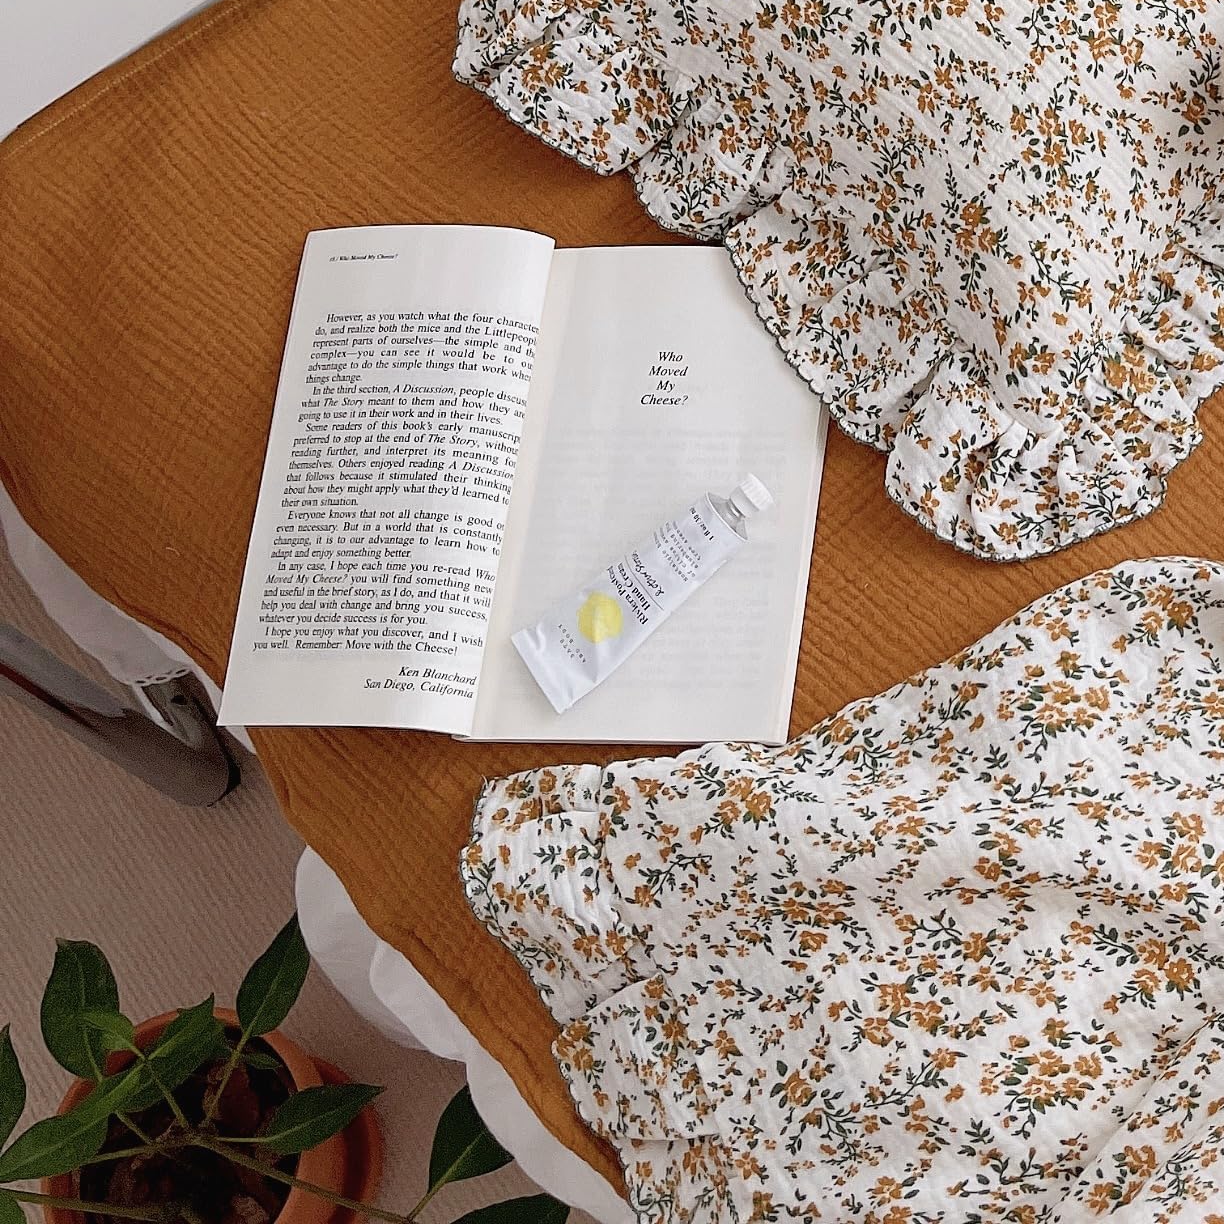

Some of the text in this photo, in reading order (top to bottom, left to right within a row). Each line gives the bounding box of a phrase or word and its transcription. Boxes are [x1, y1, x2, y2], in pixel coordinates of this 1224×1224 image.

[472, 313, 493, 323] four
[346, 324, 375, 332] realize
[377, 324, 397, 332] both
[464, 337, 498, 350] simple
[441, 348, 474, 357] would
[658, 351, 684, 363] Who
[391, 360, 422, 369] simple
[425, 360, 455, 370] things
[648, 365, 689, 377] Moved
[402, 385, 457, 394] Discussion,
[459, 386, 494, 399] people
[656, 380, 676, 393] My
[640, 393, 689, 406] Cheese?
[368, 409, 389, 417] their
[449, 410, 474, 419] their
[488, 402, 510, 415] they
[331, 422, 362, 430] readers
[437, 422, 463, 433] early
[343, 434, 362, 444] stop
[393, 434, 410, 442] end
[385, 447, 427, 456] interpret
[452, 448, 499, 465] meaning
[337, 459, 445, 470] Others enjoyed reading
[388, 472, 437, 480] stimulated
[473, 476, 511, 493] thinking
[346, 484, 499, 502] might apply learned
[287, 510, 326, 521] Everyone
[413, 510, 449, 522] change
[368, 535, 415, 545] advantage
[434, 537, 461, 547] learn
[452, 525, 502, 544] constantly
[311, 550, 334, 558] enjoy
[336, 548, 382, 558] something
[433, 563, 470, 576] re-read
[415, 575, 470, 591] something
[439, 590, 460, 601] that
[472, 596, 490, 607] will
[631, 587, 650, 609] Hand
[339, 601, 372, 610] change
[394, 601, 420, 612] bring
[624, 593, 648, 624] Riviera
[311, 627, 483, 646] enjoy discover, wish
[415, 642, 456, 655] Cheese!
[398, 667, 475, 686] Ken Blanchard
[364, 680, 472, 699] San Diego, California
